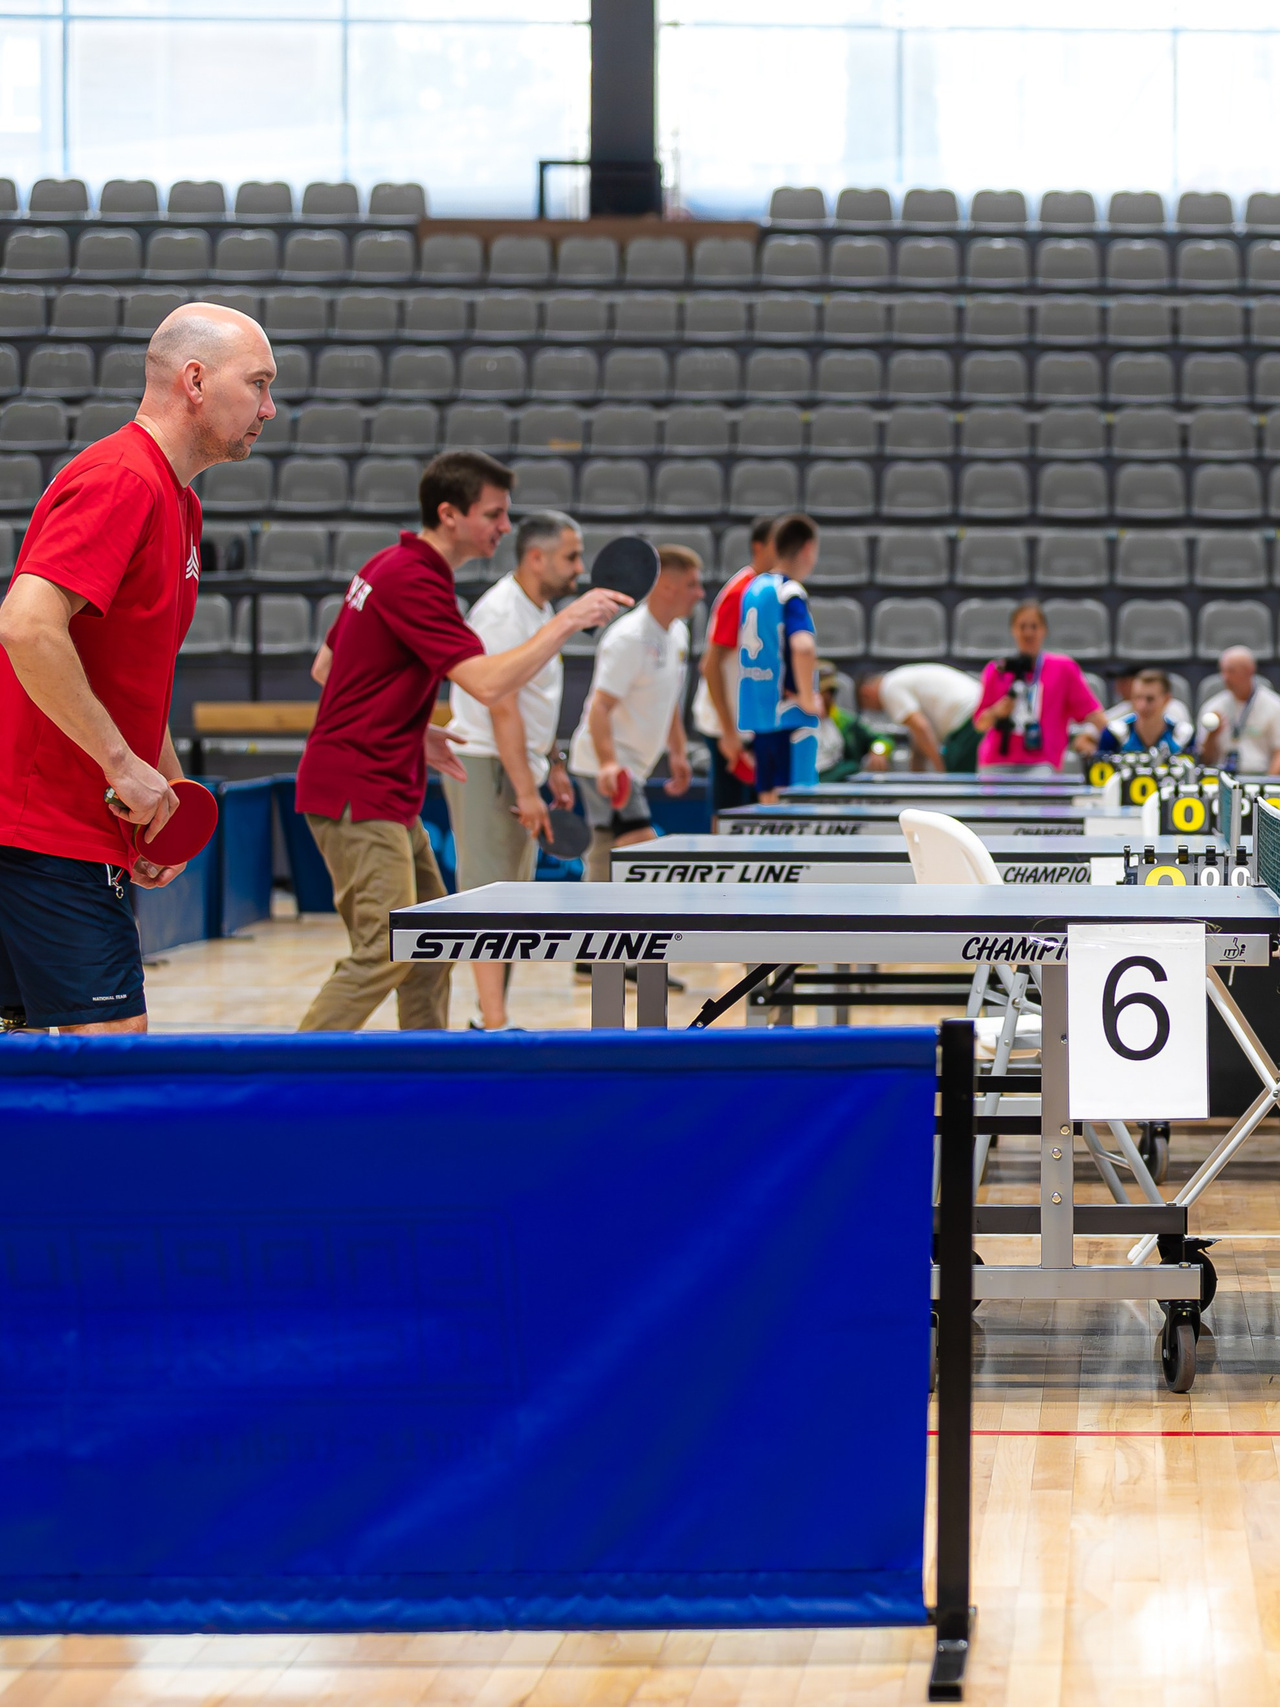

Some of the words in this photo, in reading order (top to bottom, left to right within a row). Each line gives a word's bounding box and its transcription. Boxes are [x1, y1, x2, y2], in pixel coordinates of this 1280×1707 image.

[1129, 776, 1157, 805] 0
[1172, 797, 1205, 832] 0
[625, 864, 734, 883] START
[1004, 866, 1091, 883] CHAMPIO
[410, 932, 572, 960] START
[961, 936, 1069, 961] CHAMPI
[1102, 956, 1170, 1061] 6
